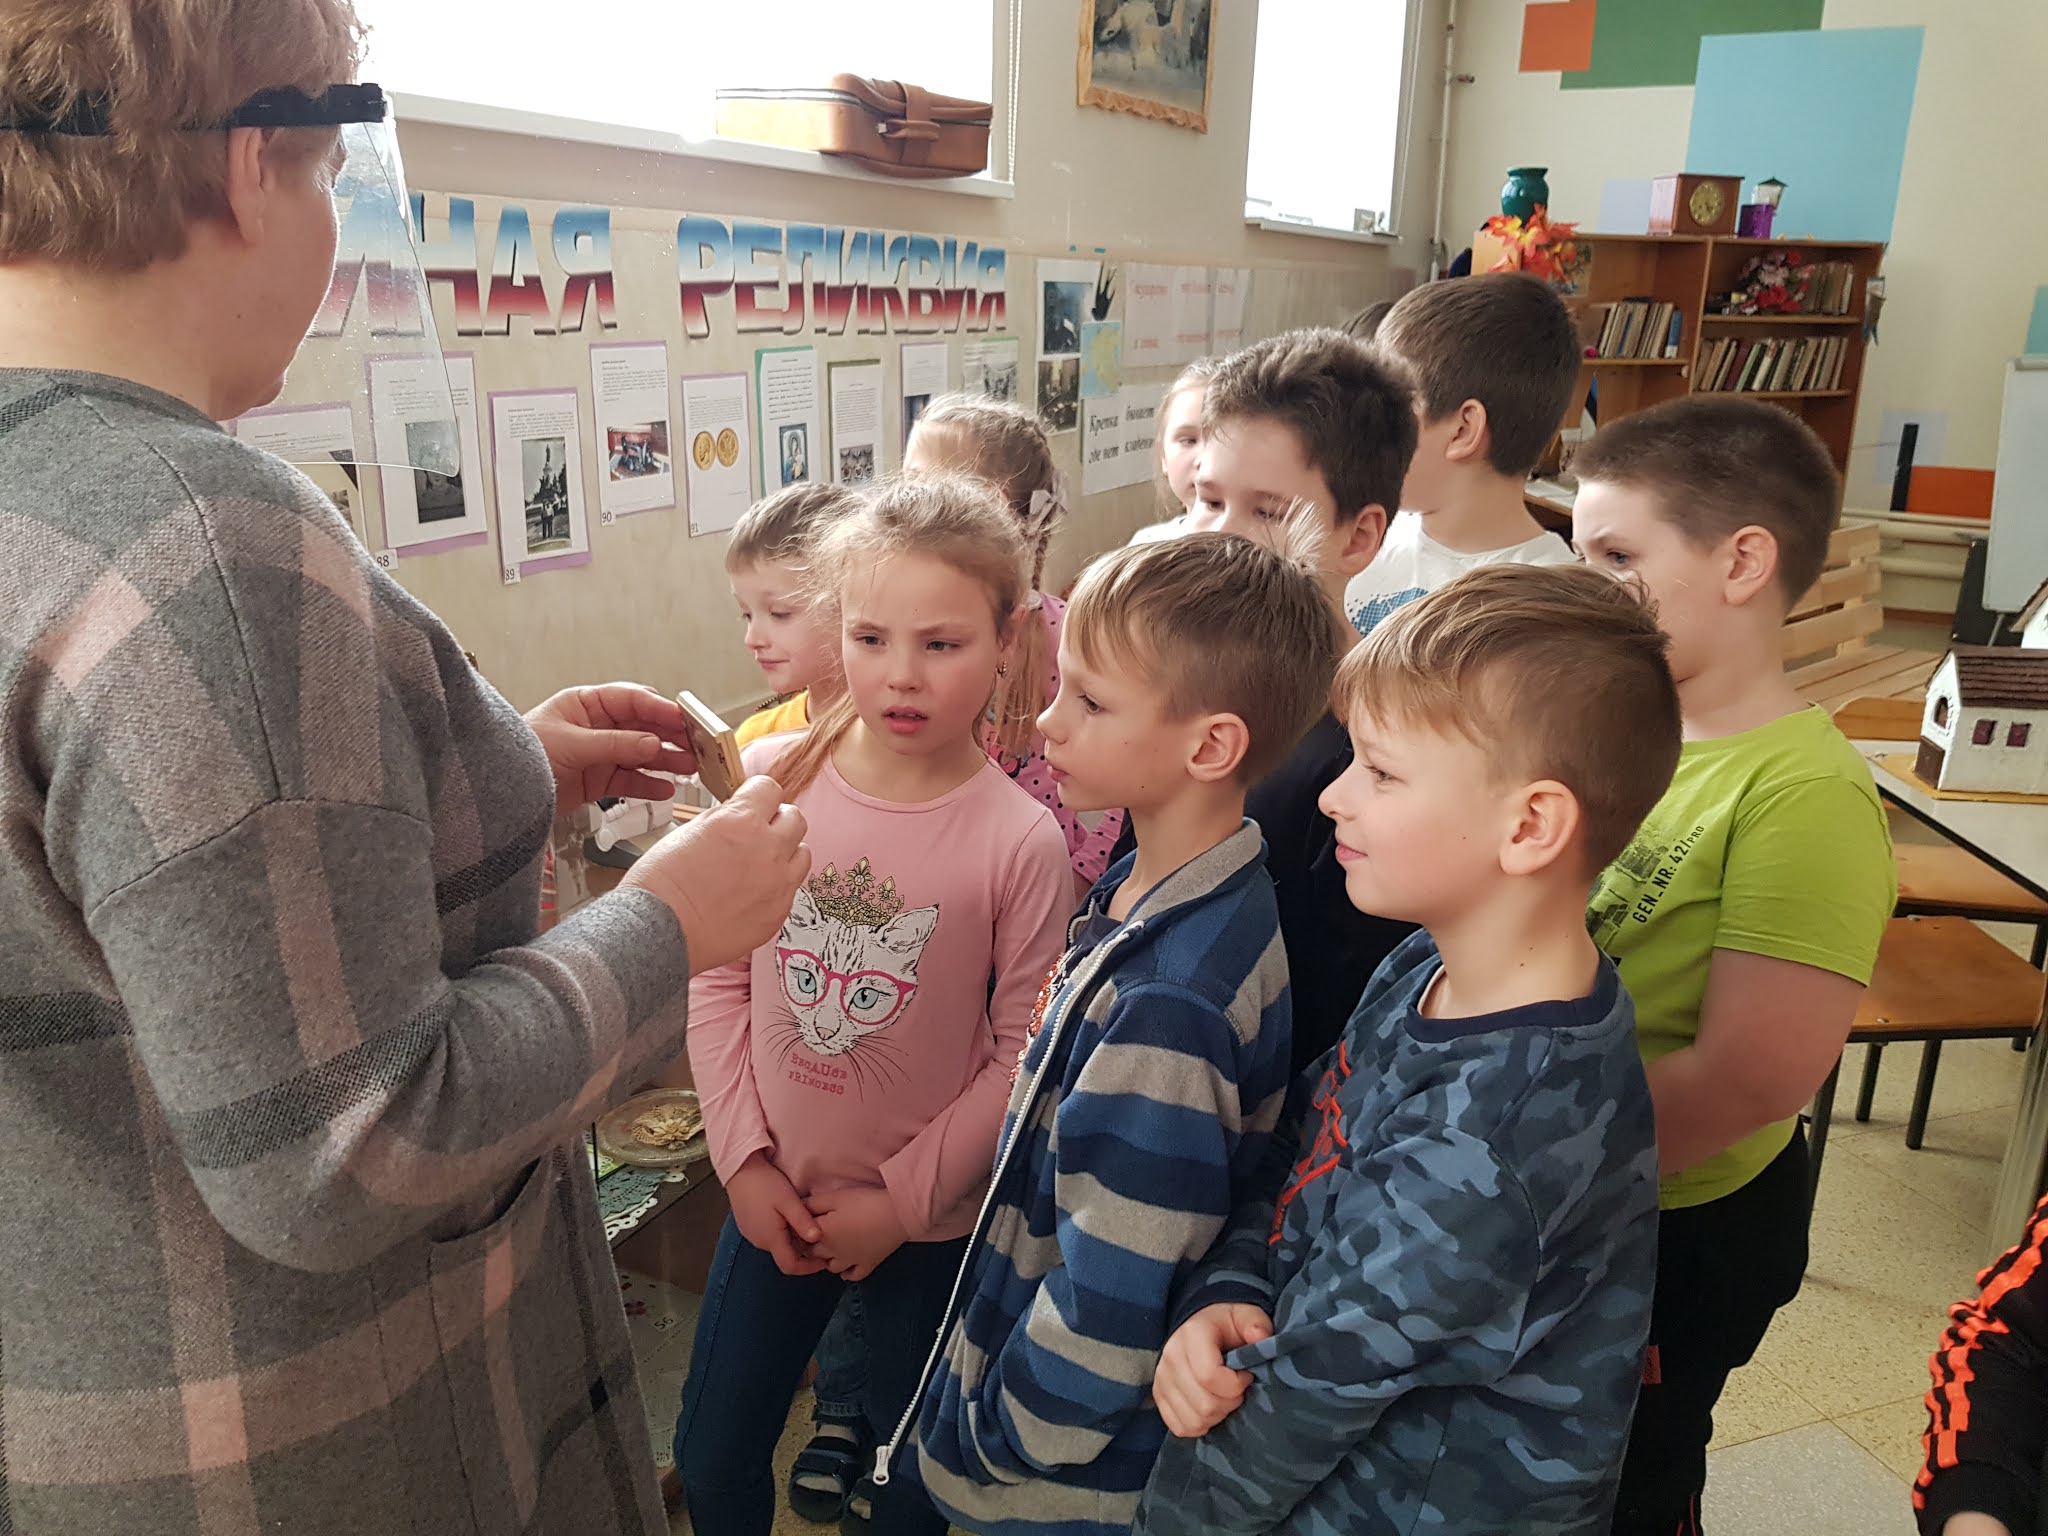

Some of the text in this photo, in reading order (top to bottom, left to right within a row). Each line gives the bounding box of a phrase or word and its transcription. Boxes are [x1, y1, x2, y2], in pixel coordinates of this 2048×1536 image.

[677, 214, 1007, 339] РЕЛИКВИЯ
[602, 511, 612, 523] 90
[505, 568, 515, 581] 89
[788, 1071, 844, 1095] PRINCESS
